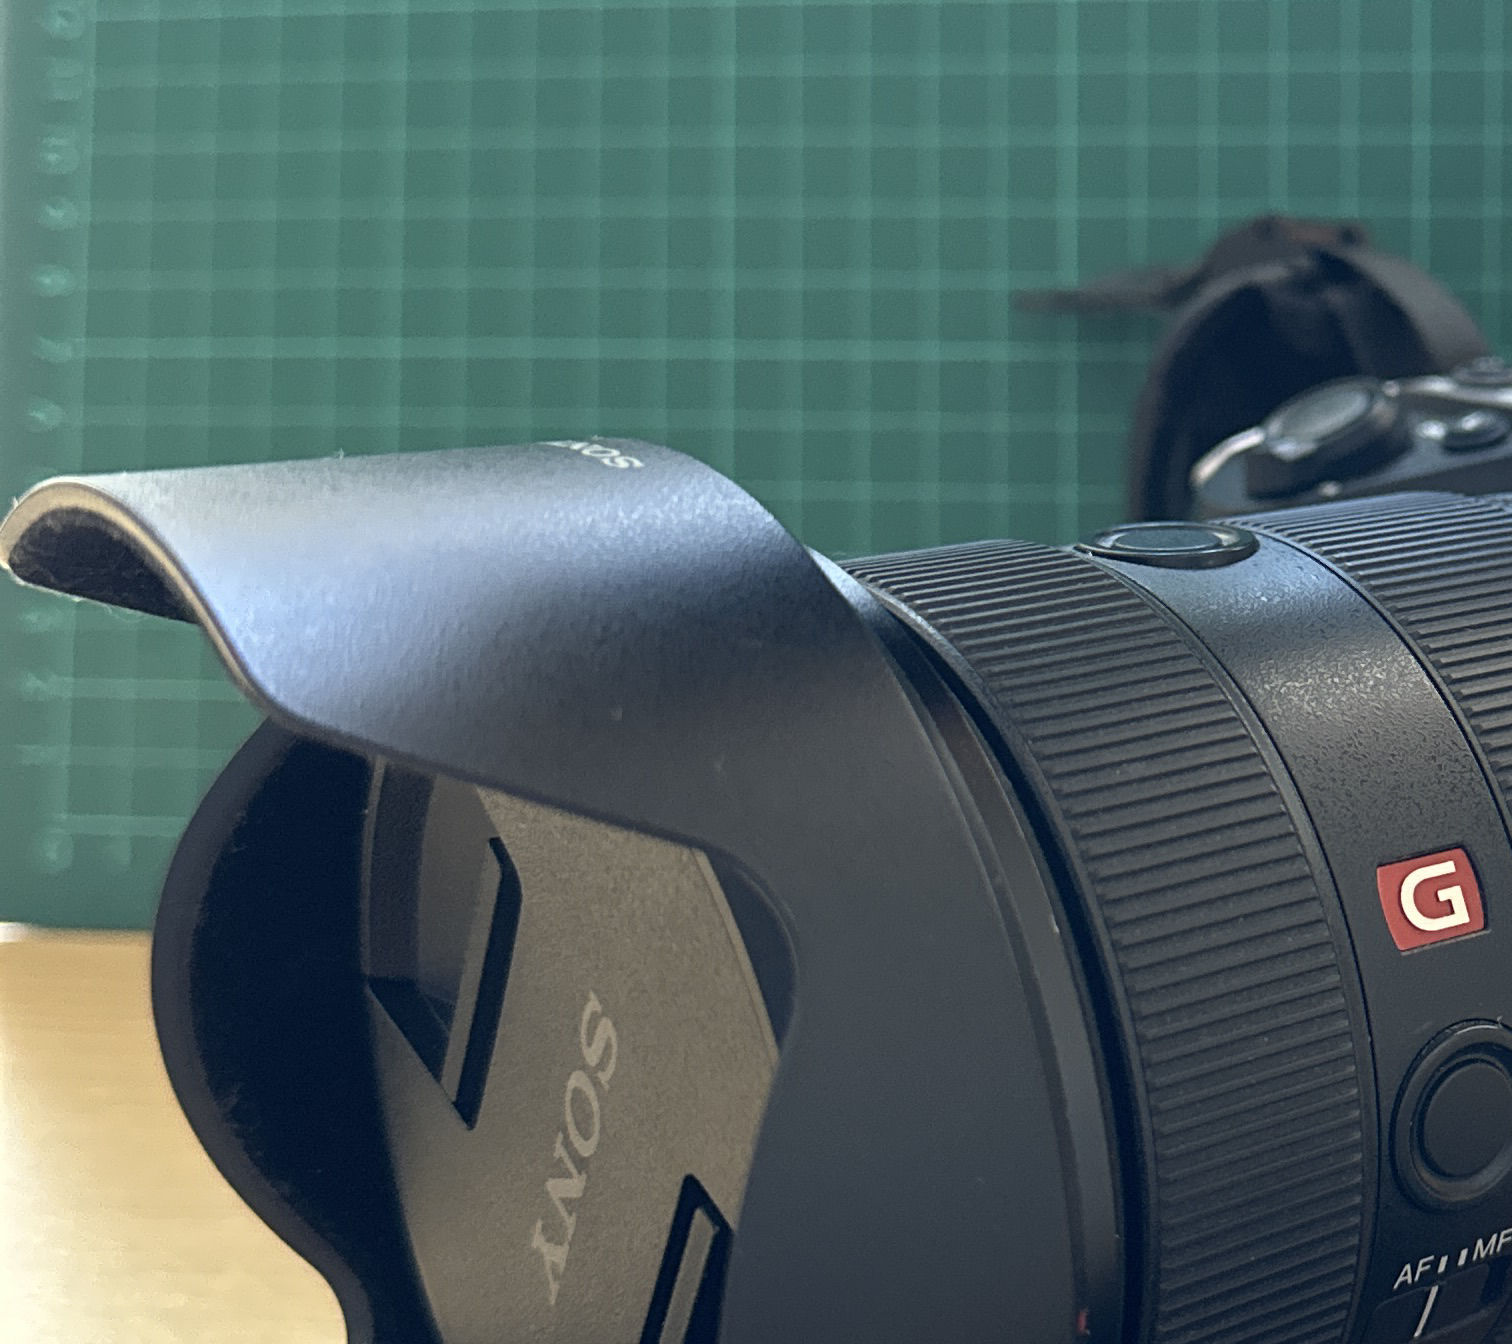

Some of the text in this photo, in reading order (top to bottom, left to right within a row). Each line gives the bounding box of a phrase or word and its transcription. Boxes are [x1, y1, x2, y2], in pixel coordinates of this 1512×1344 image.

[1400, 860, 1470, 932] G
[531, 991, 618, 1306] SONY
[1393, 1255, 1435, 1290] AF
